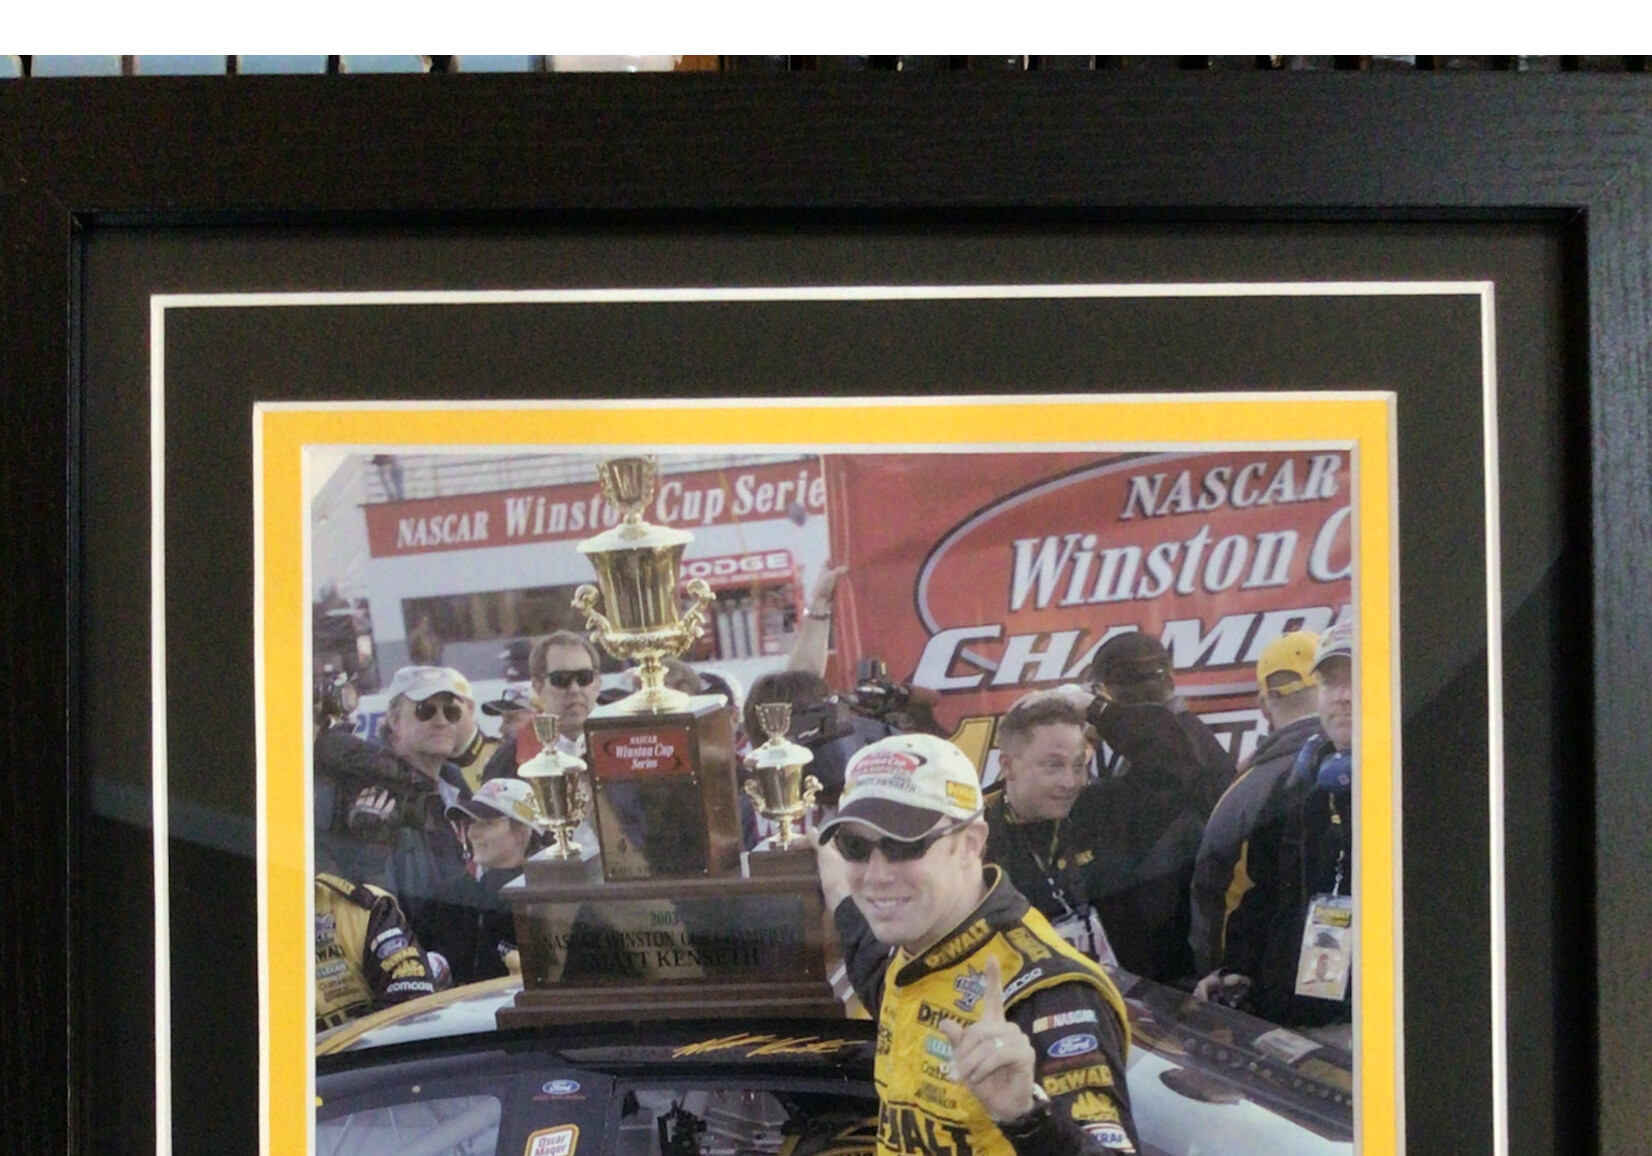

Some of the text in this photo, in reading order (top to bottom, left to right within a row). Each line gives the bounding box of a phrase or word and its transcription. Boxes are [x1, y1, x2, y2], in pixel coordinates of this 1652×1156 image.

[1120, 455, 1342, 520] NASCAR
[397, 468, 826, 548] NASCAR Winsto Cup Serie
[1008, 525, 1298, 612] Winston
[616, 743, 674, 758] Winston Cup
[651, 911, 680, 927] 2003
[1057, 1034, 1090, 1054] Ford
[538, 1135, 566, 1147] Oscar
